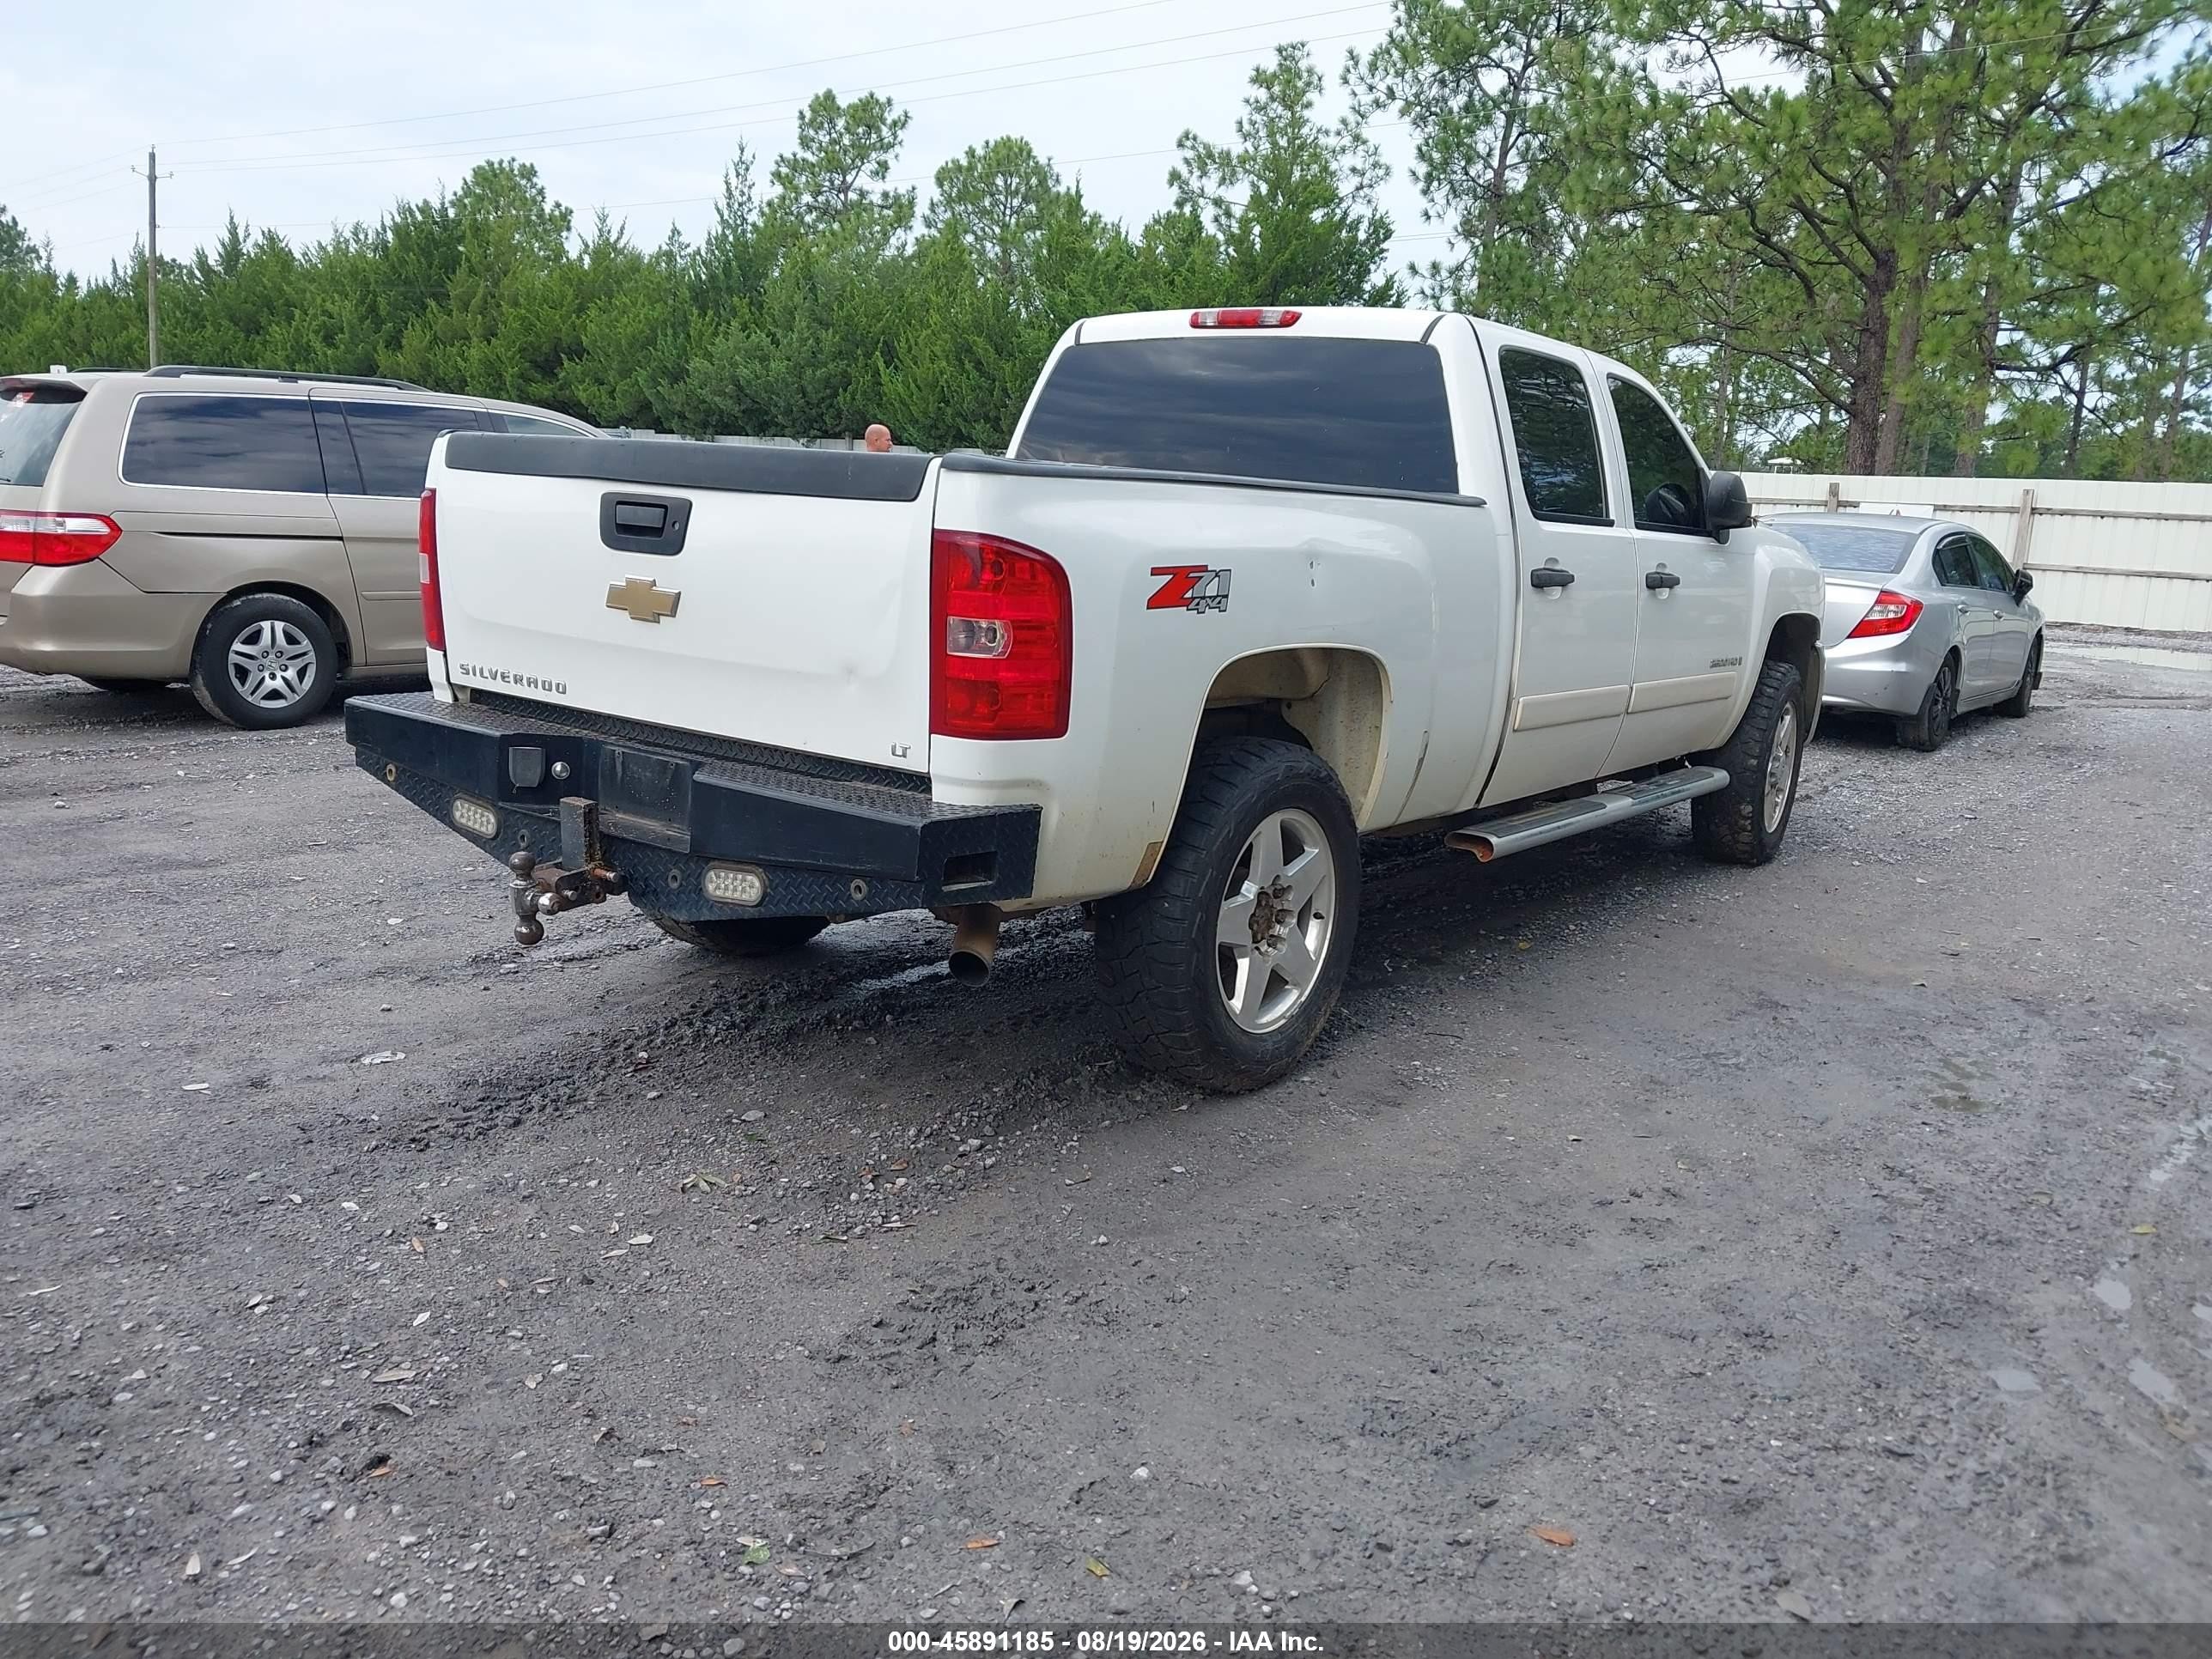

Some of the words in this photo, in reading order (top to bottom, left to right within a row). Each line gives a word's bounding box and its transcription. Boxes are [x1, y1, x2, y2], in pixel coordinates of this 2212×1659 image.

[1146, 564, 1231, 611] Z71
[459, 662, 567, 695] SILVERADO
[890, 741, 912, 759] LT
